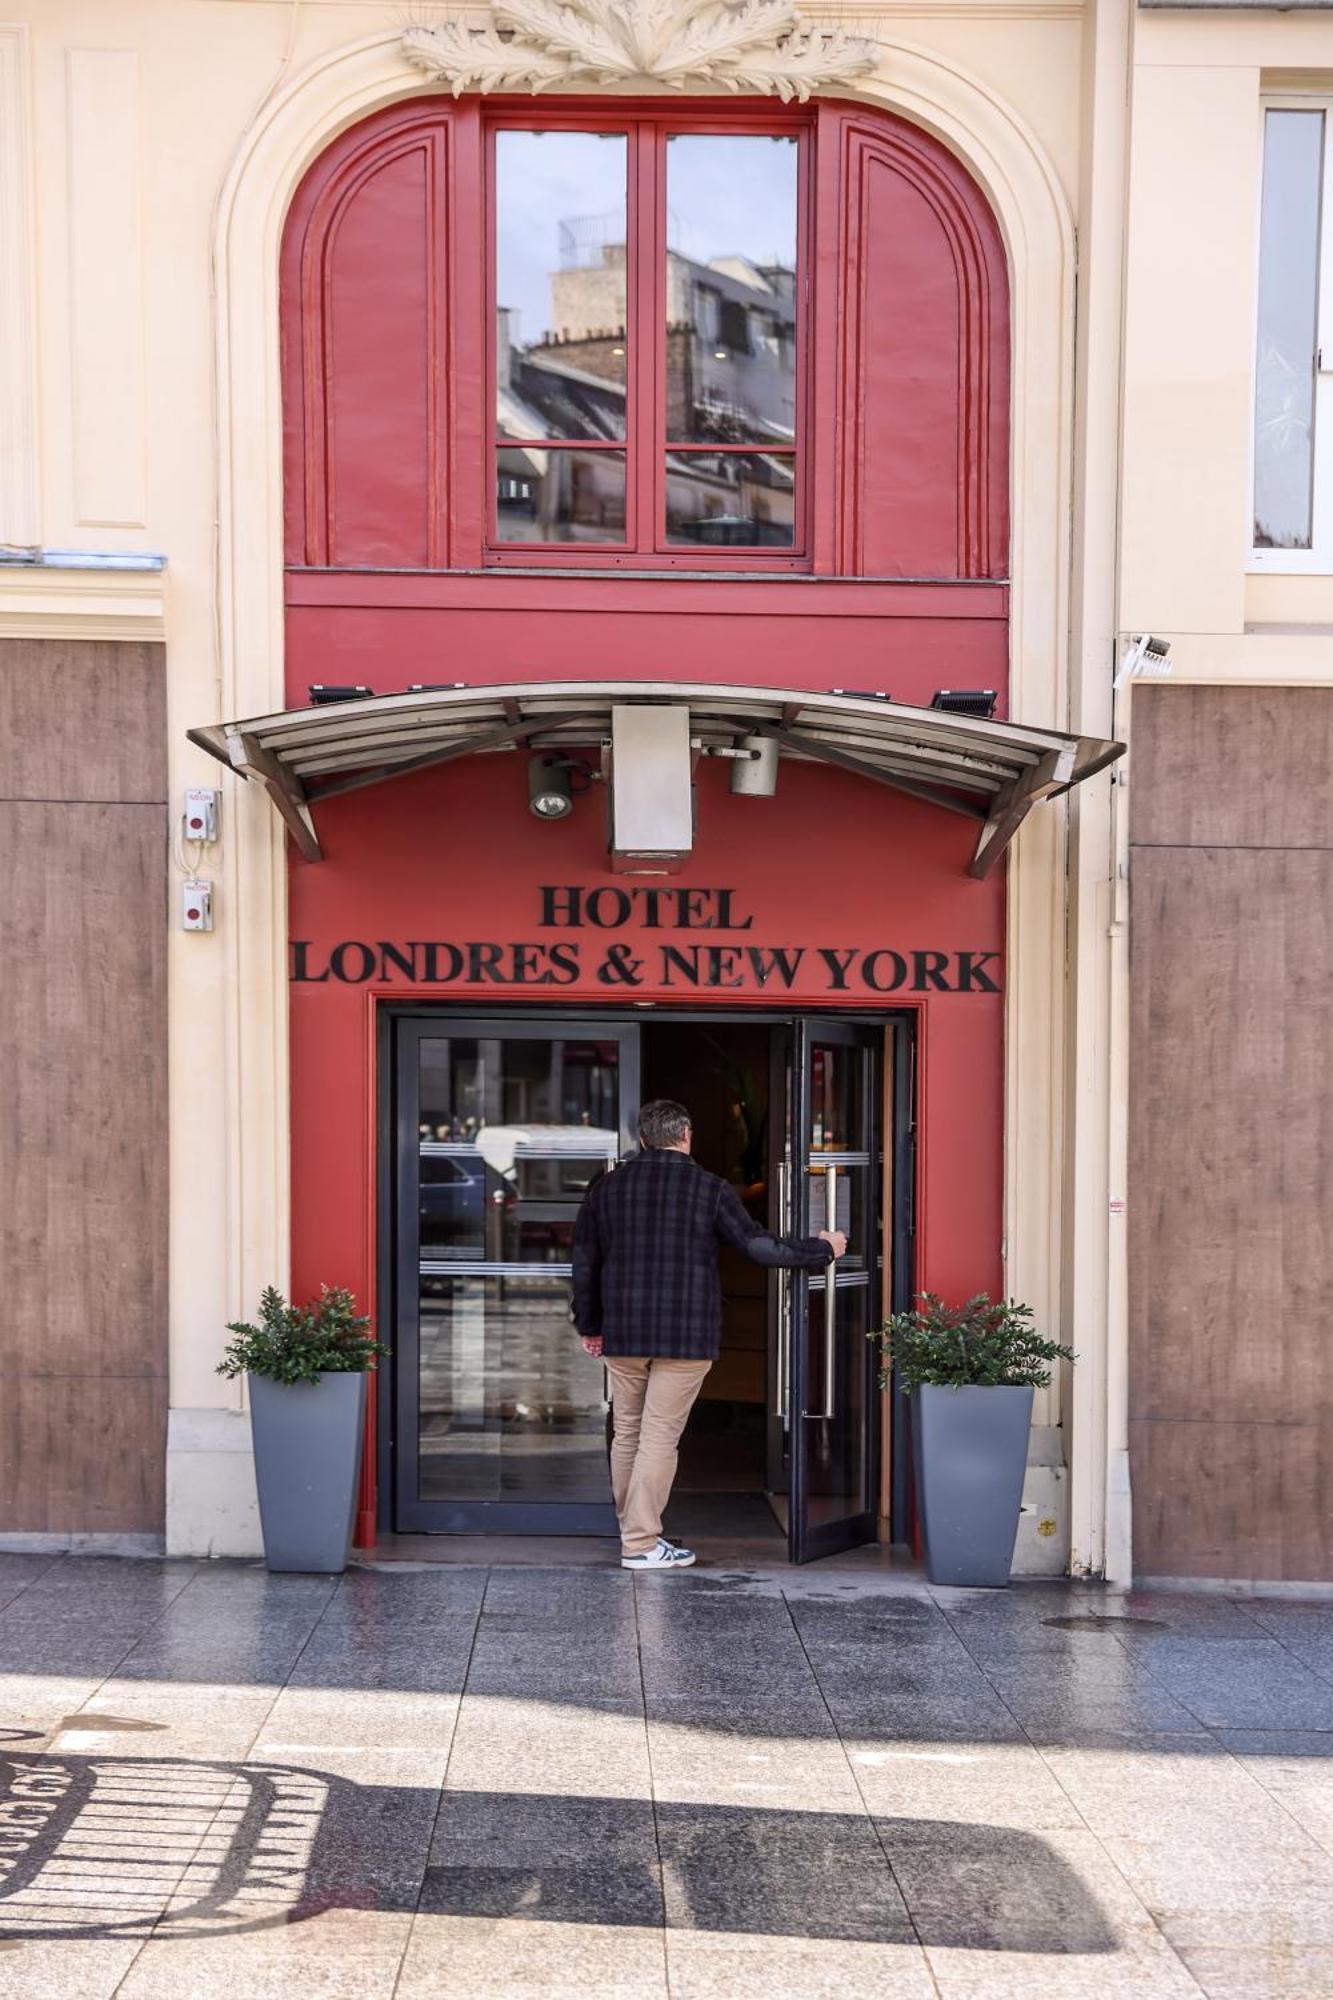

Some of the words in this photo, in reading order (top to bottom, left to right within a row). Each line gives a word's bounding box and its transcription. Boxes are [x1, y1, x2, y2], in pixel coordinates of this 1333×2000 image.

[538, 886, 753, 930] HOTEL
[288, 941, 580, 985] LONDRES
[598, 944, 642, 986] &
[660, 946, 805, 988] NEW
[817, 949, 1002, 994] YORK
